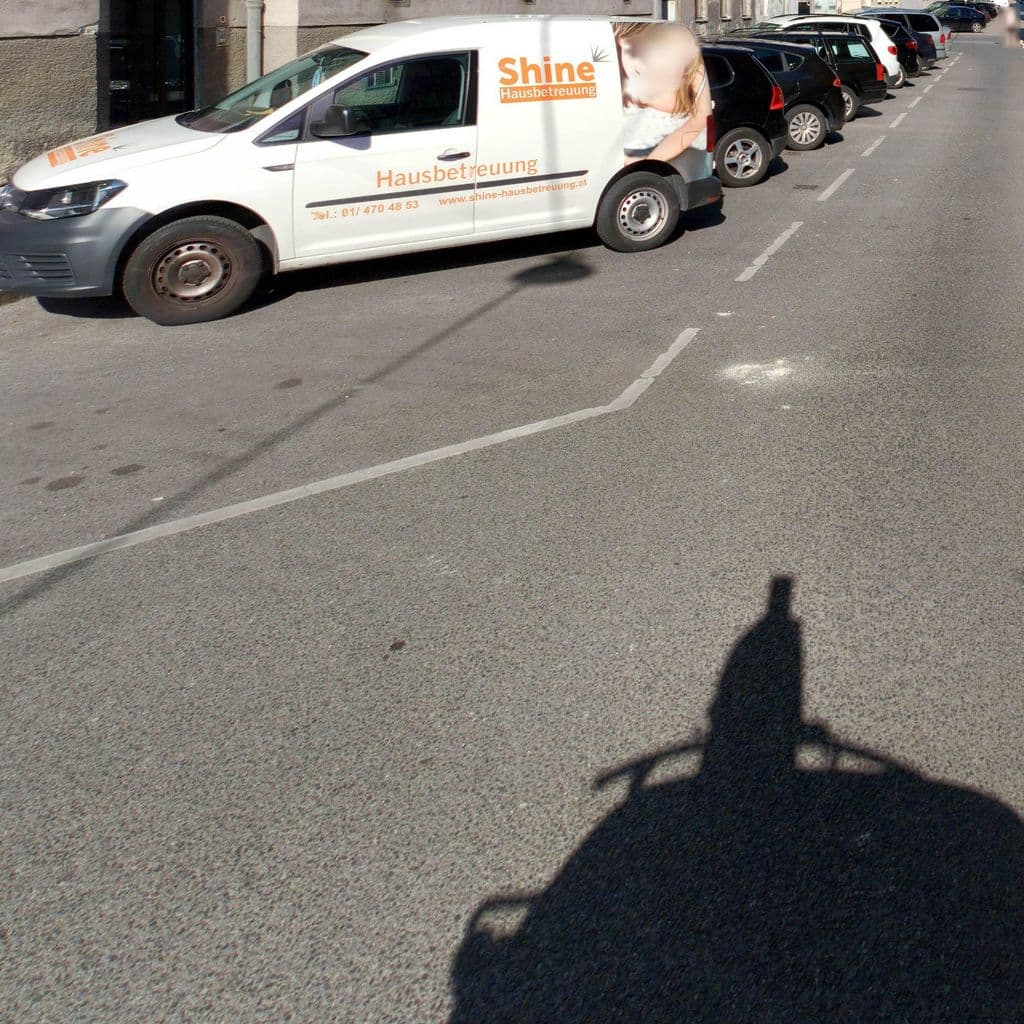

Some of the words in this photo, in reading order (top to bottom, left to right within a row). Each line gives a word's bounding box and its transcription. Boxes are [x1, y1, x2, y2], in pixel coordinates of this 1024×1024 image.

[498, 56, 596, 86] Shine
[500, 85, 596, 99] Hausbetreuung
[376, 158, 538, 189] Hausbetreuung
[363, 204, 385, 215] 470
[387, 202, 402, 212] 48
[405, 200, 420, 210] 53
[437, 178, 588, 206] www.shine-hausbetreuung.at
